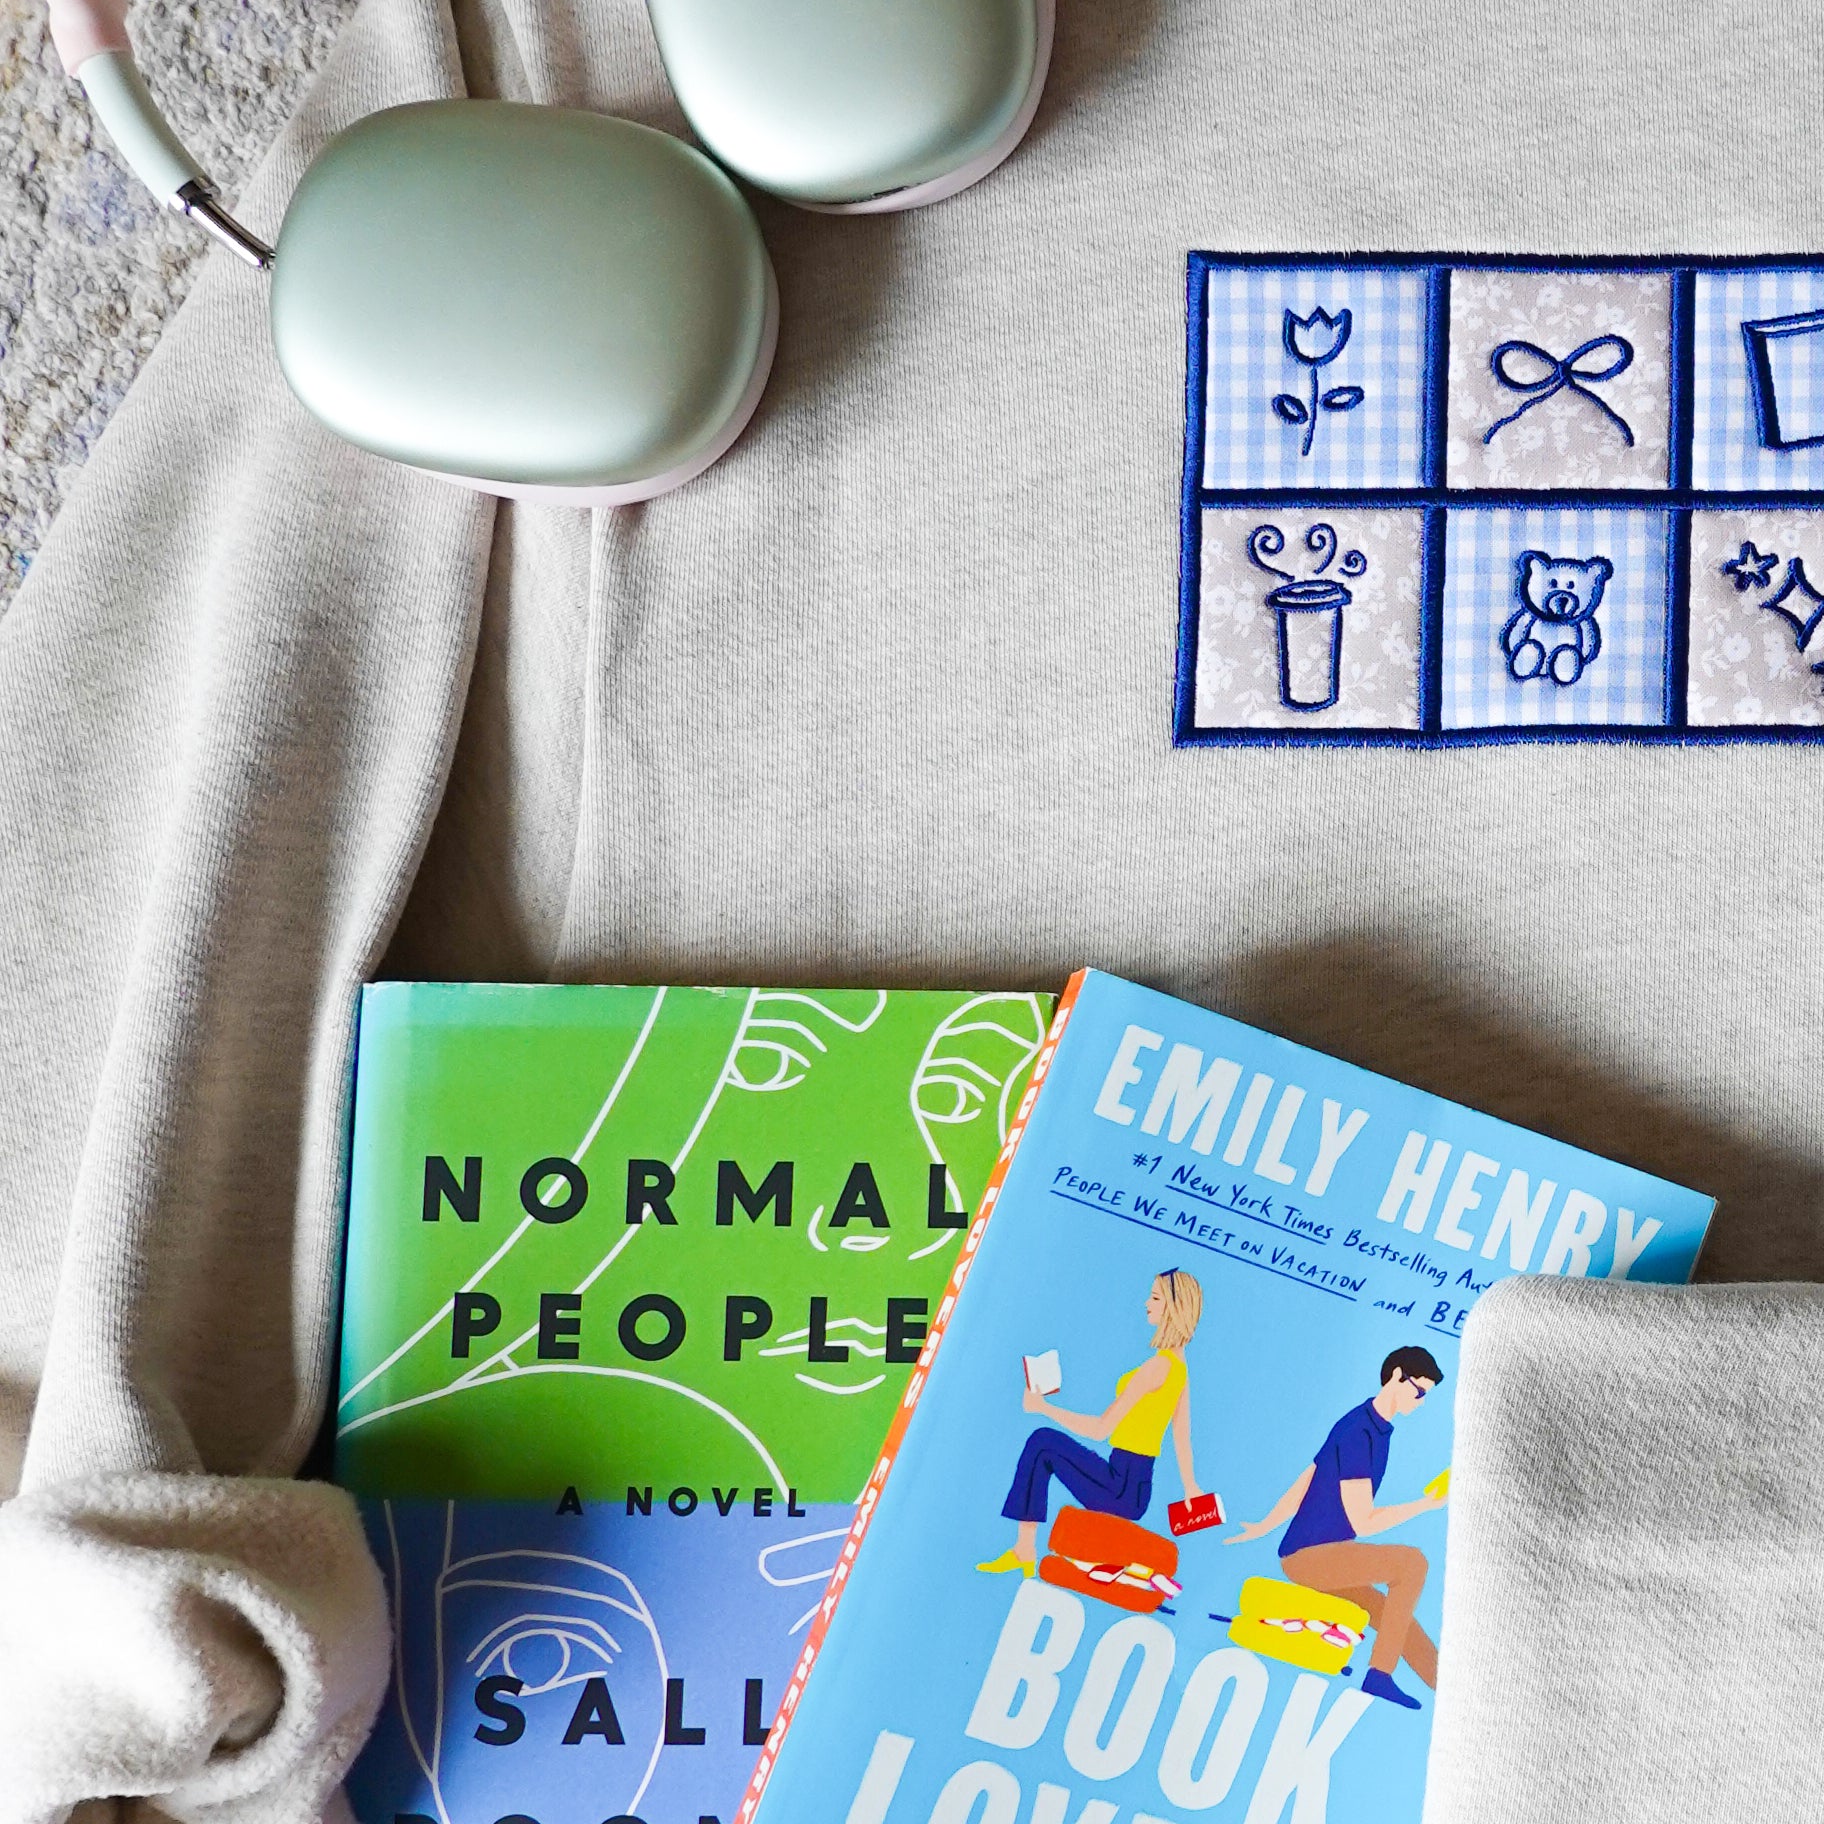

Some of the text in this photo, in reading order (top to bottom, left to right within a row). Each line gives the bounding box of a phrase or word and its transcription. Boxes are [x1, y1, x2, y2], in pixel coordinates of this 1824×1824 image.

[421, 1154, 969, 1230] NORMAL
[903, 1006, 1071, 1408] BOOK LOVERS
[1094, 1025, 1663, 1280] EMILY HENRY
[1052, 1167, 1125, 1205] PEOPLE
[1134, 1196, 1167, 1220] WE
[1175, 1211, 1235, 1246] MEET
[1267, 1247, 1366, 1291] VACATION
[1373, 1301, 1415, 1316] and
[1133, 1154, 1162, 1174] #1
[1167, 1165, 1220, 1196] New
[1227, 1184, 1272, 1218] York
[1278, 1206, 1333, 1240] Times
[1343, 1229, 1447, 1287] Bestselling
[450, 1290, 930, 1364] PEOPLE
[556, 1484, 811, 1519] A NOVEL
[821, 1456, 891, 1624] EMILY
[1174, 1506, 1218, 1532] a novel
